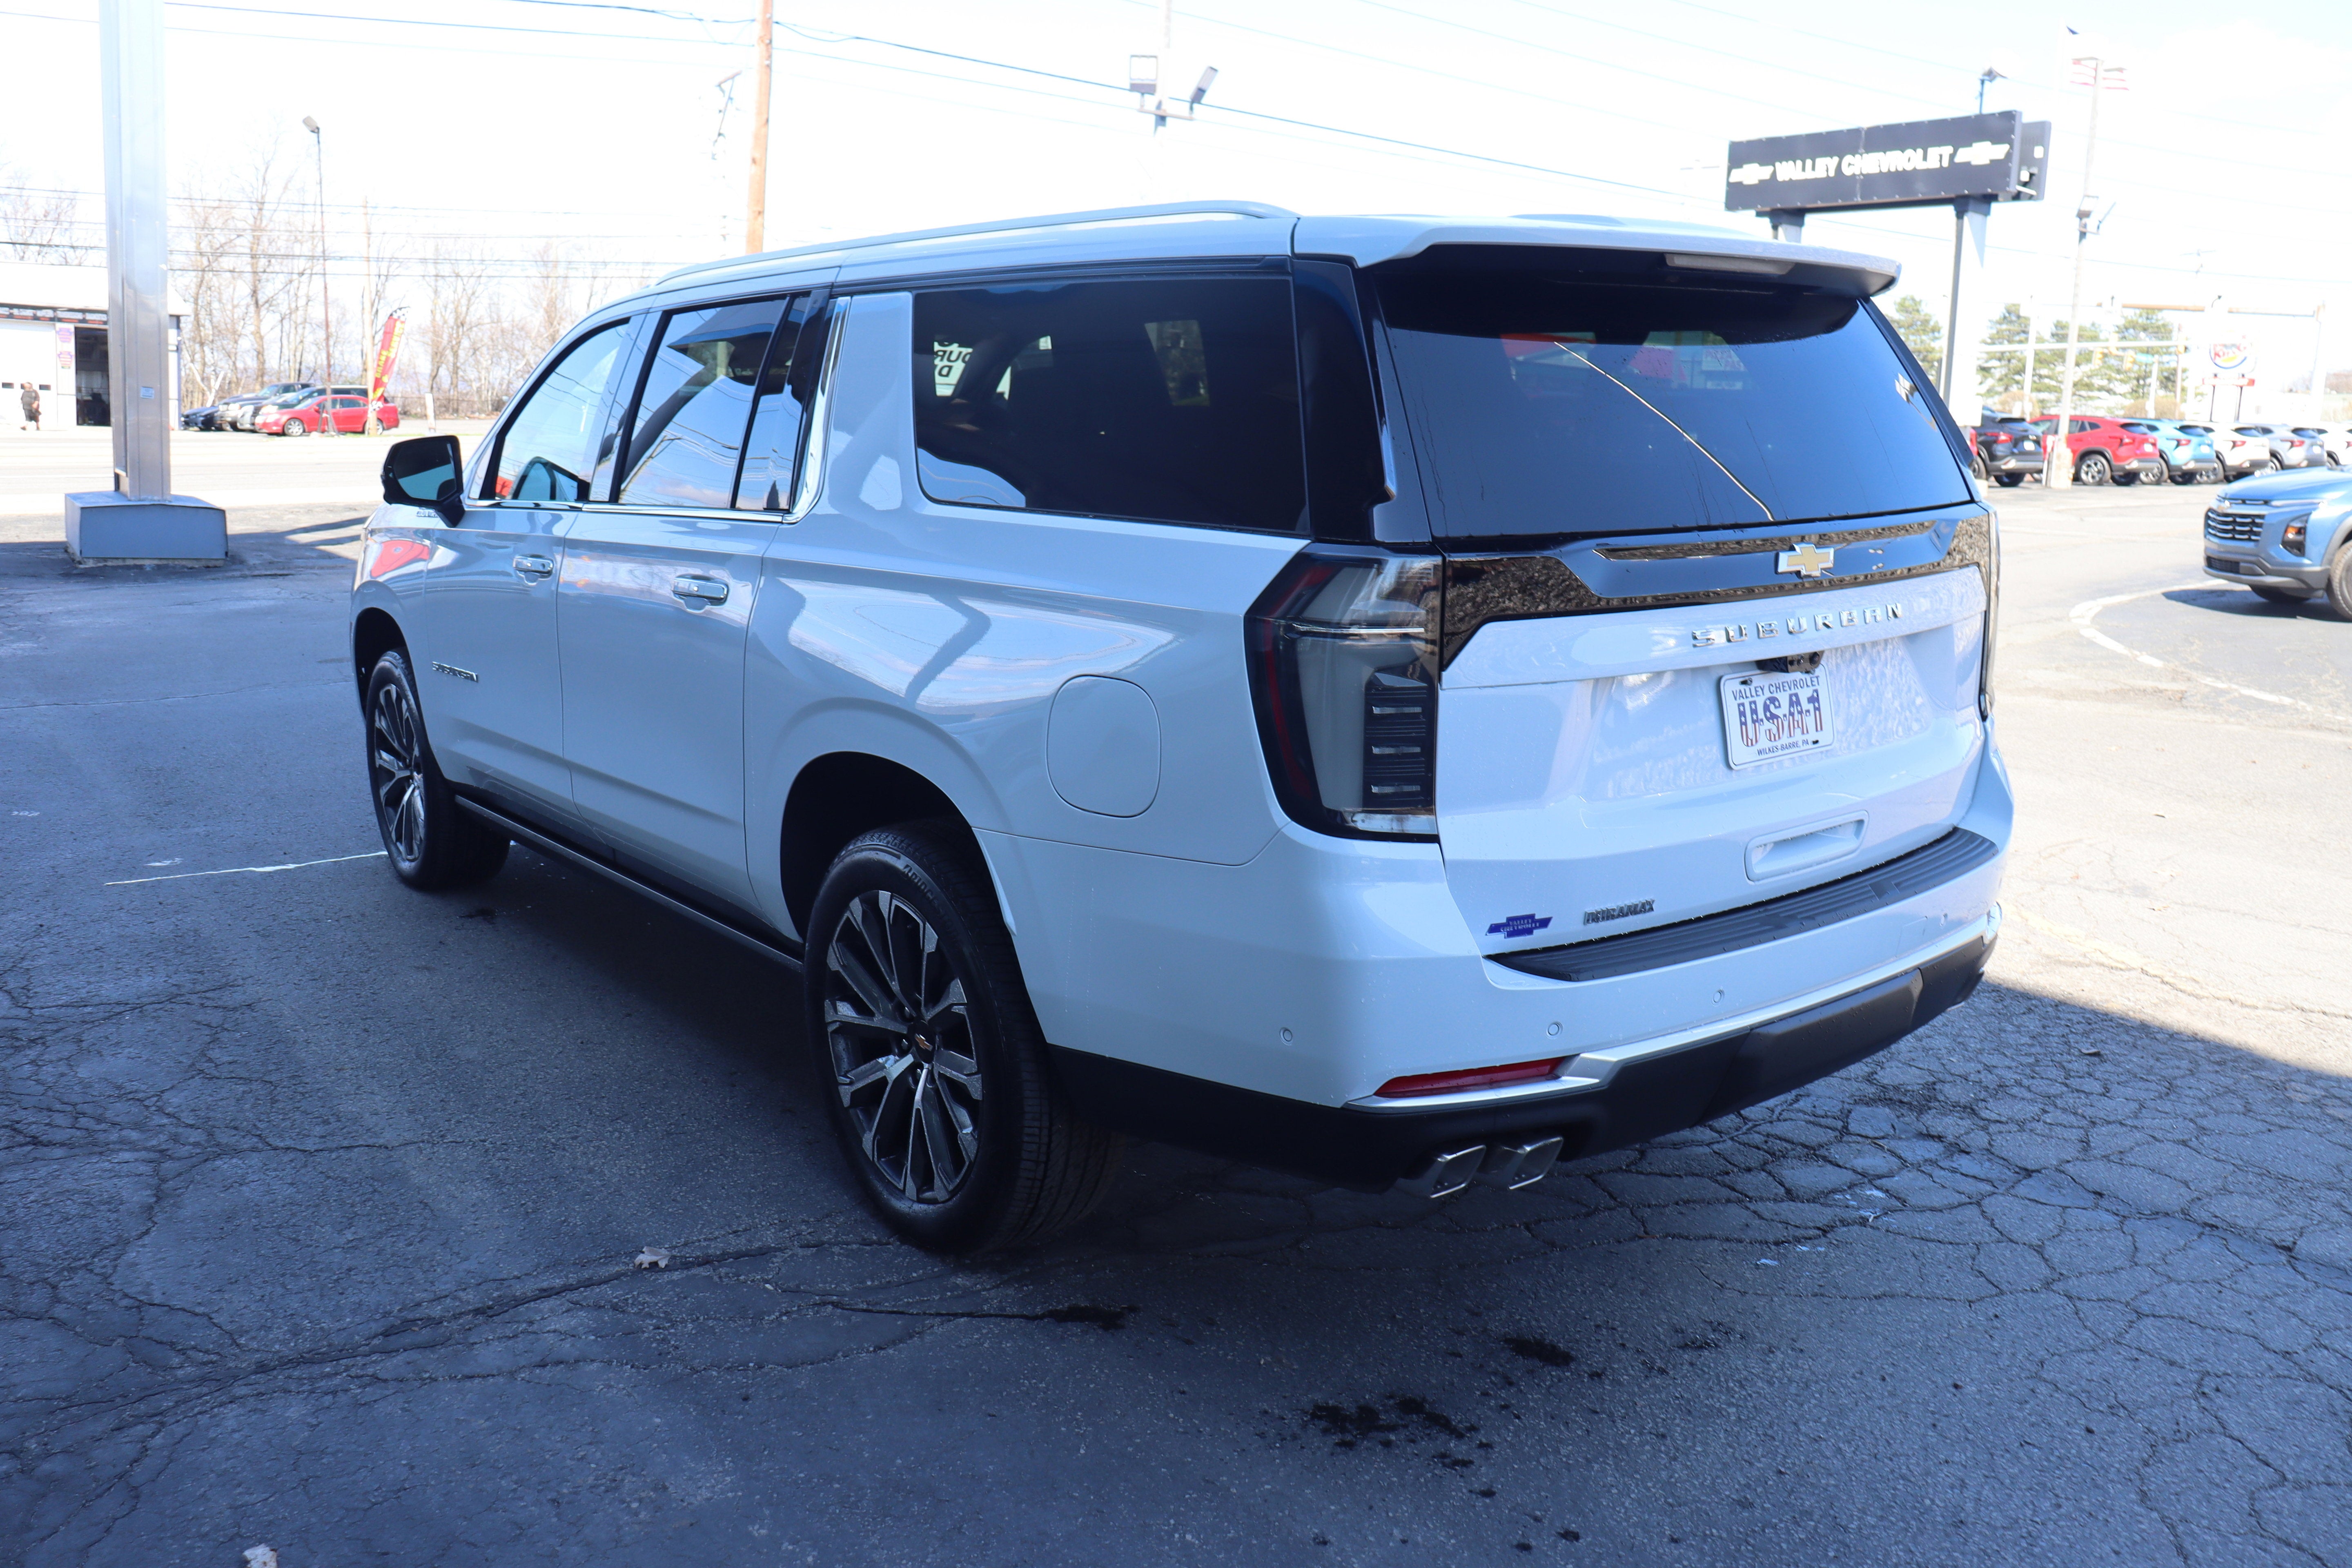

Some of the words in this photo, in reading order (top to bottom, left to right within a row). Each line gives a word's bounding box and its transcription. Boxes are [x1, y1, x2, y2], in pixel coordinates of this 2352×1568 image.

[1775, 156, 1839, 181] VALLEY
[1841, 146, 1953, 176] CHEVROLET
[1692, 602, 1903, 648] SUBURBAN
[1731, 685, 1765, 701] VALLEY
[1768, 675, 1820, 695] CHEVROLET
[1802, 738, 1809, 749] PA
[1584, 899, 1655, 926] DURAMAX
